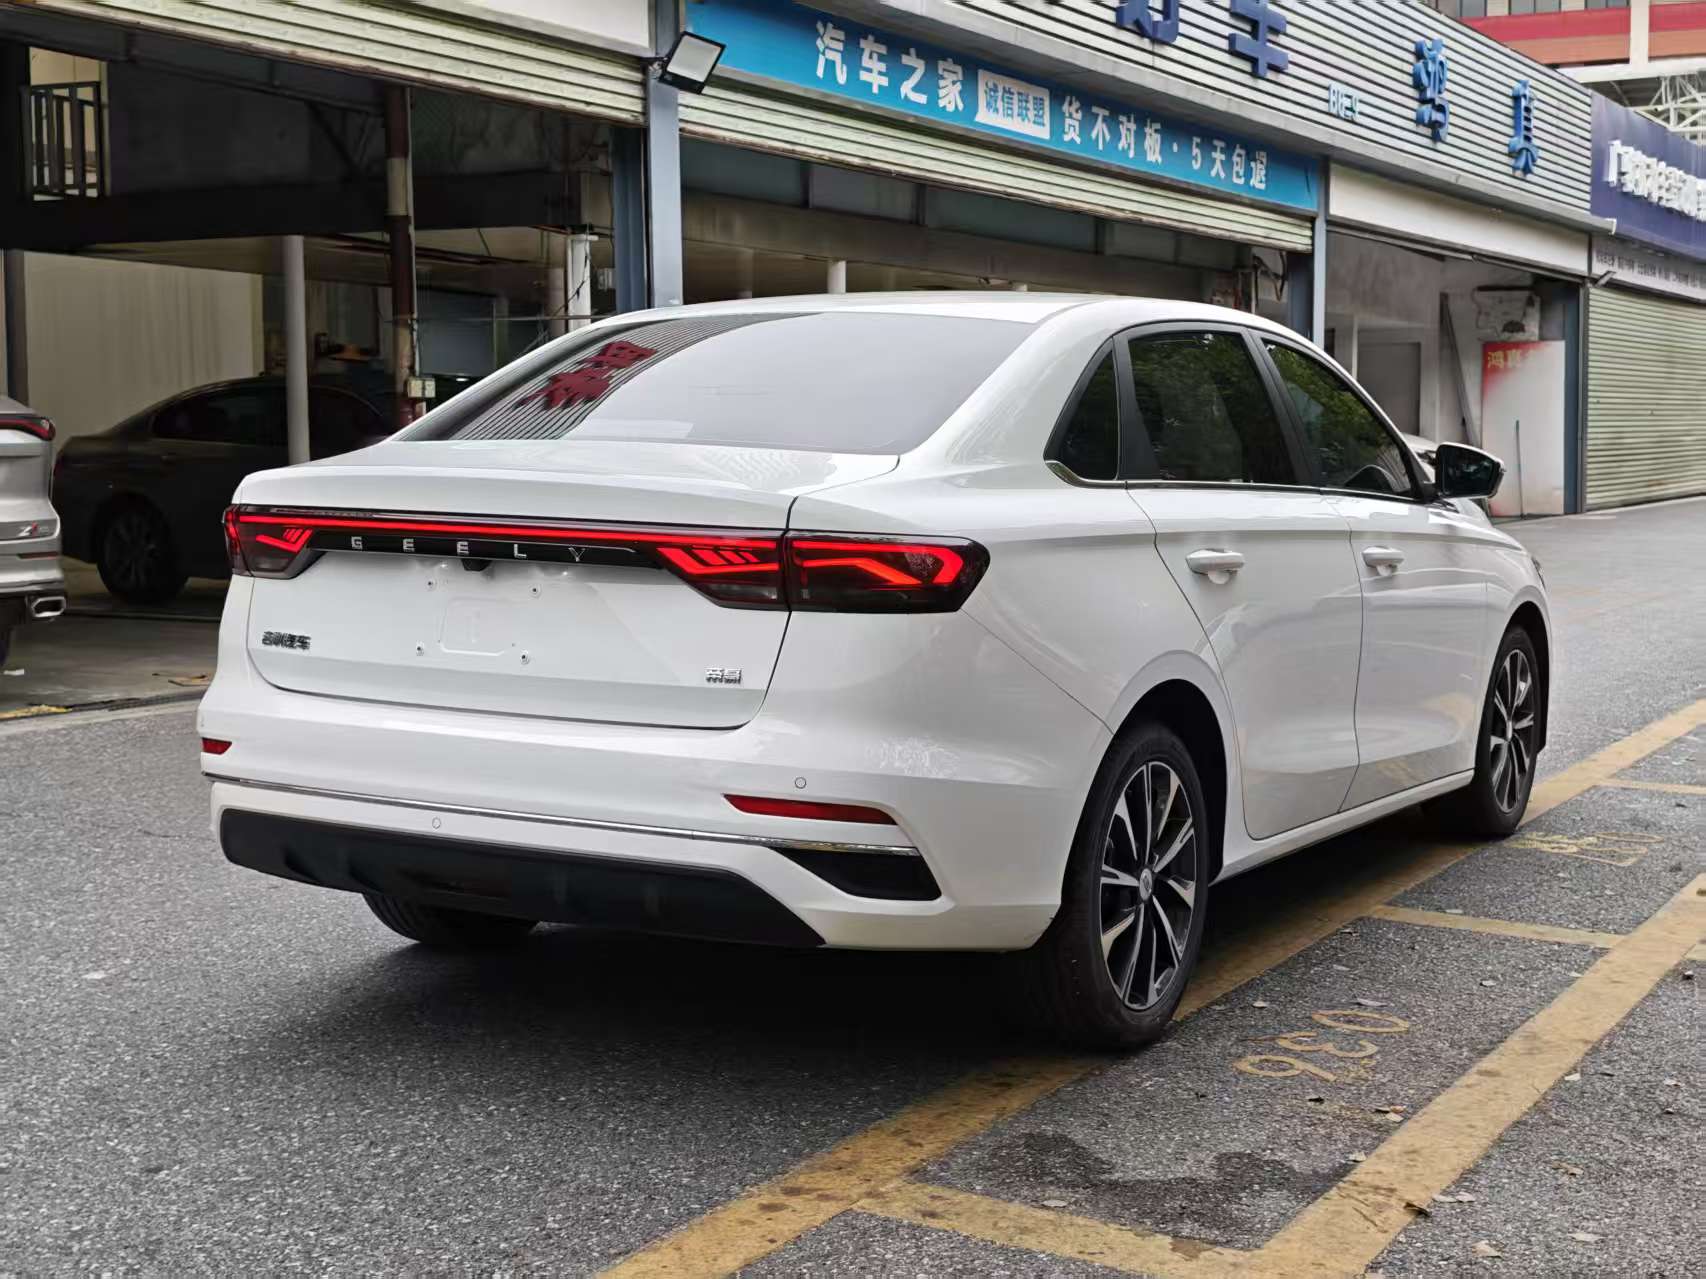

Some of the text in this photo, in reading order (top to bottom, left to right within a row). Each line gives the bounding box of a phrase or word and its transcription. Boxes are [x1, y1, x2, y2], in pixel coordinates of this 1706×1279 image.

[815, 20, 965, 113] 汽车之家
[984, 80, 1046, 128] 诚信联盟
[350, 535, 587, 563] GEELY
